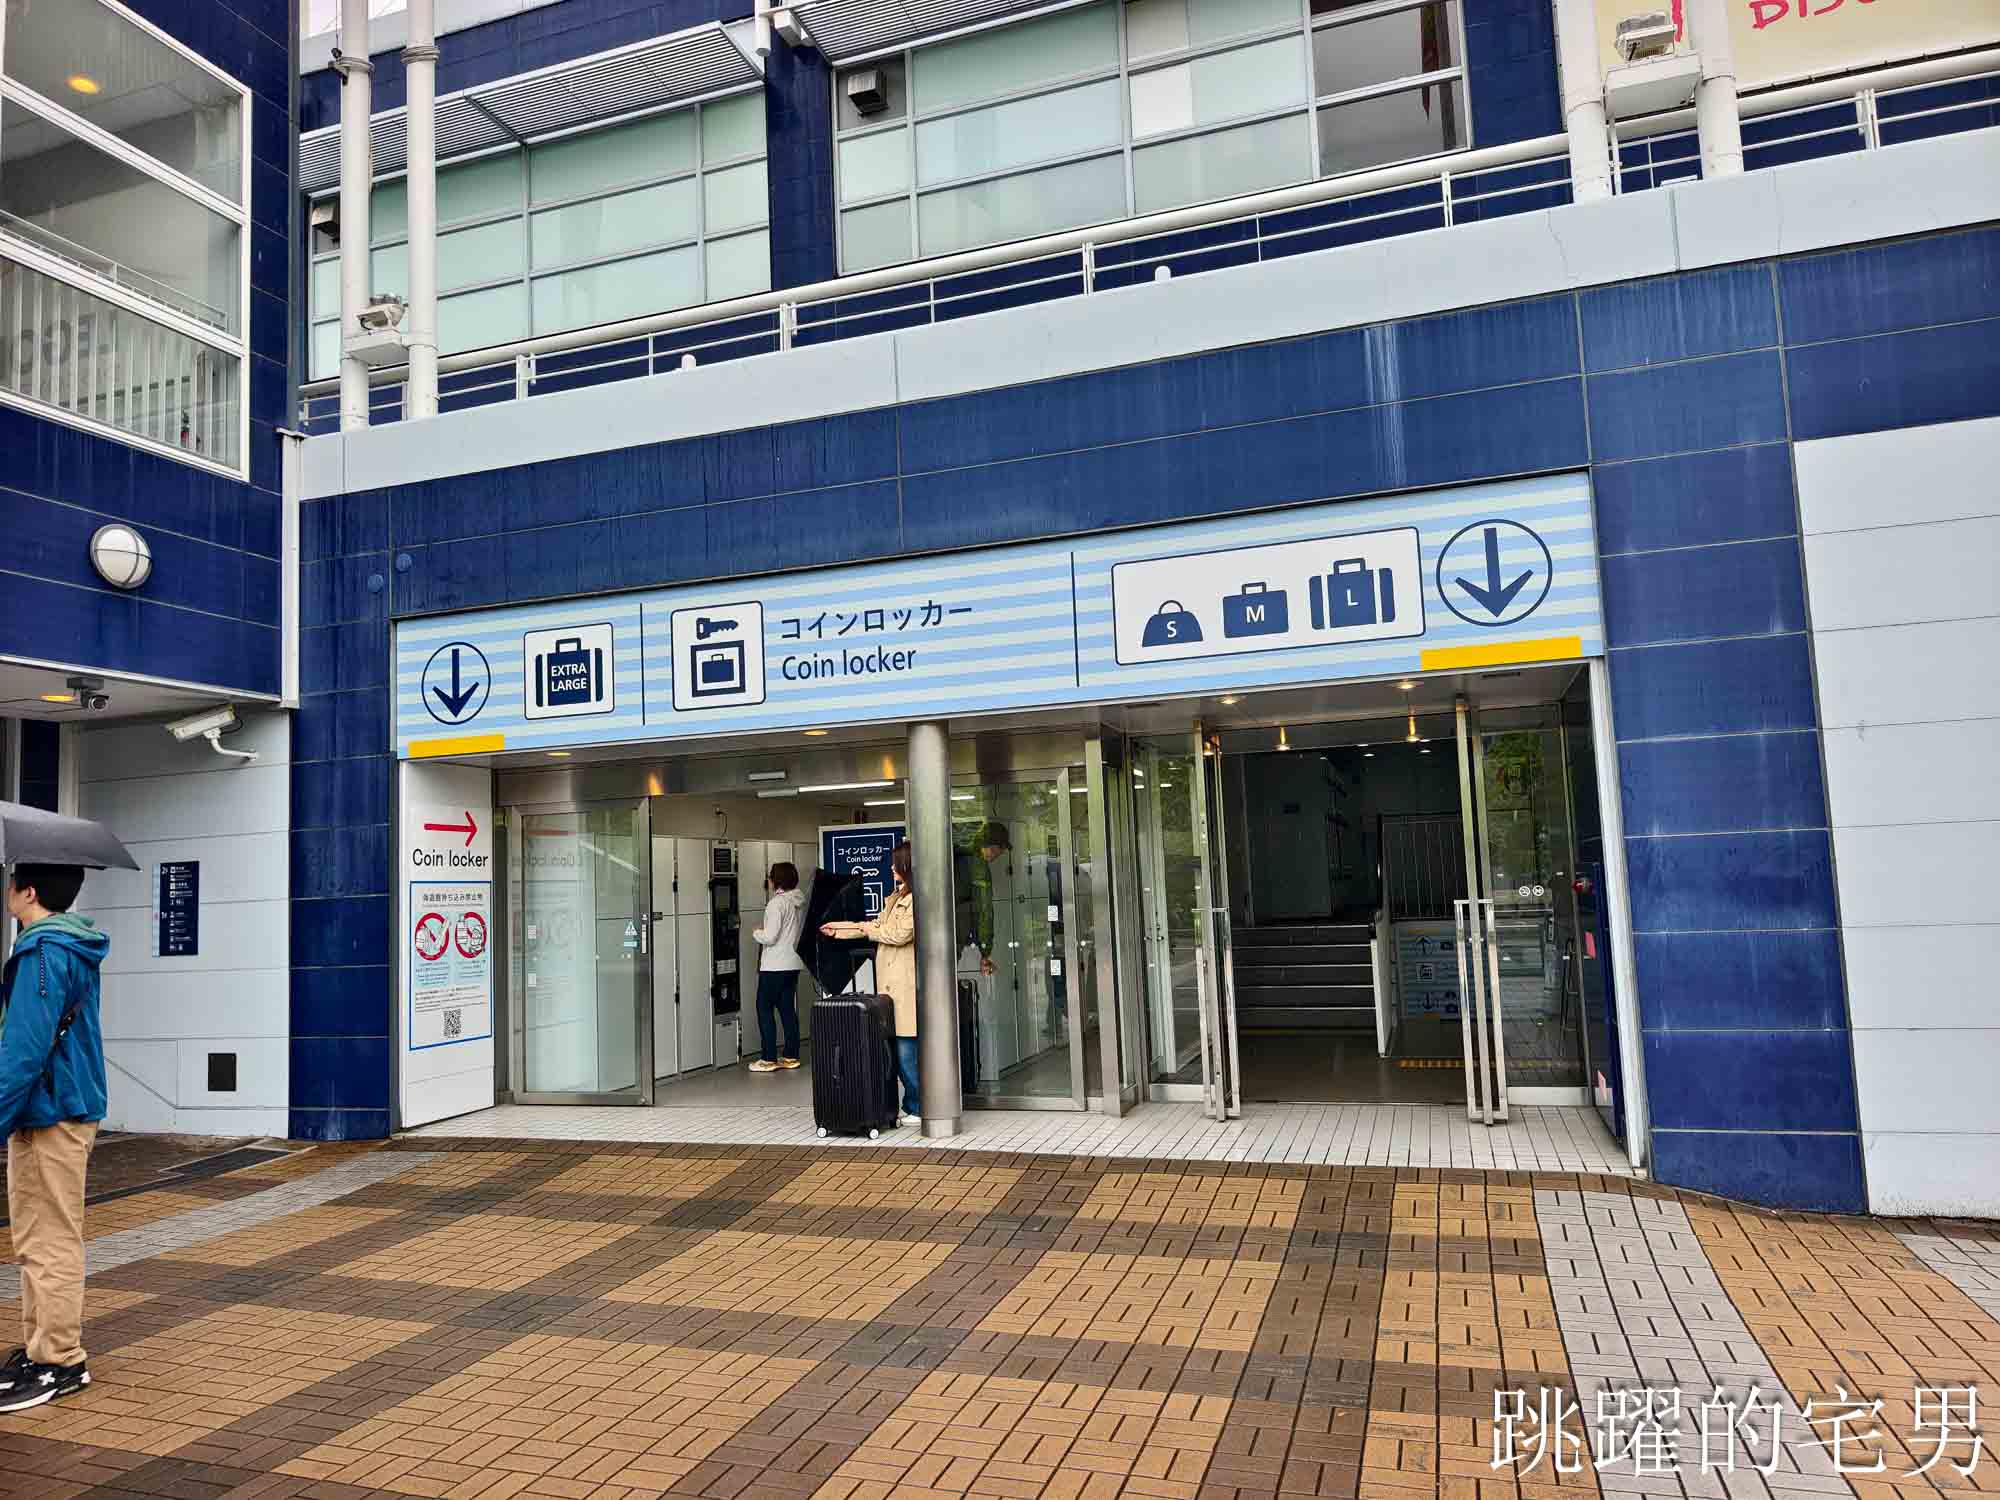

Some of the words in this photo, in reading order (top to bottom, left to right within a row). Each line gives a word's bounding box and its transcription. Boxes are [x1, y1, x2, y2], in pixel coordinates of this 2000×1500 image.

[781, 600, 972, 639] コインロッカー
[1166, 620, 1177, 638] S
[1245, 604, 1265, 624] M
[1346, 588, 1359, 606] L
[551, 663, 587, 677] EXTRA
[782, 652, 834, 681] Coin
[843, 645, 917, 676] locker
[551, 678, 587, 692] LARGE
[412, 848, 444, 866] Coin
[448, 849, 489, 867] locker
[838, 846, 890, 855] コインロッカー
